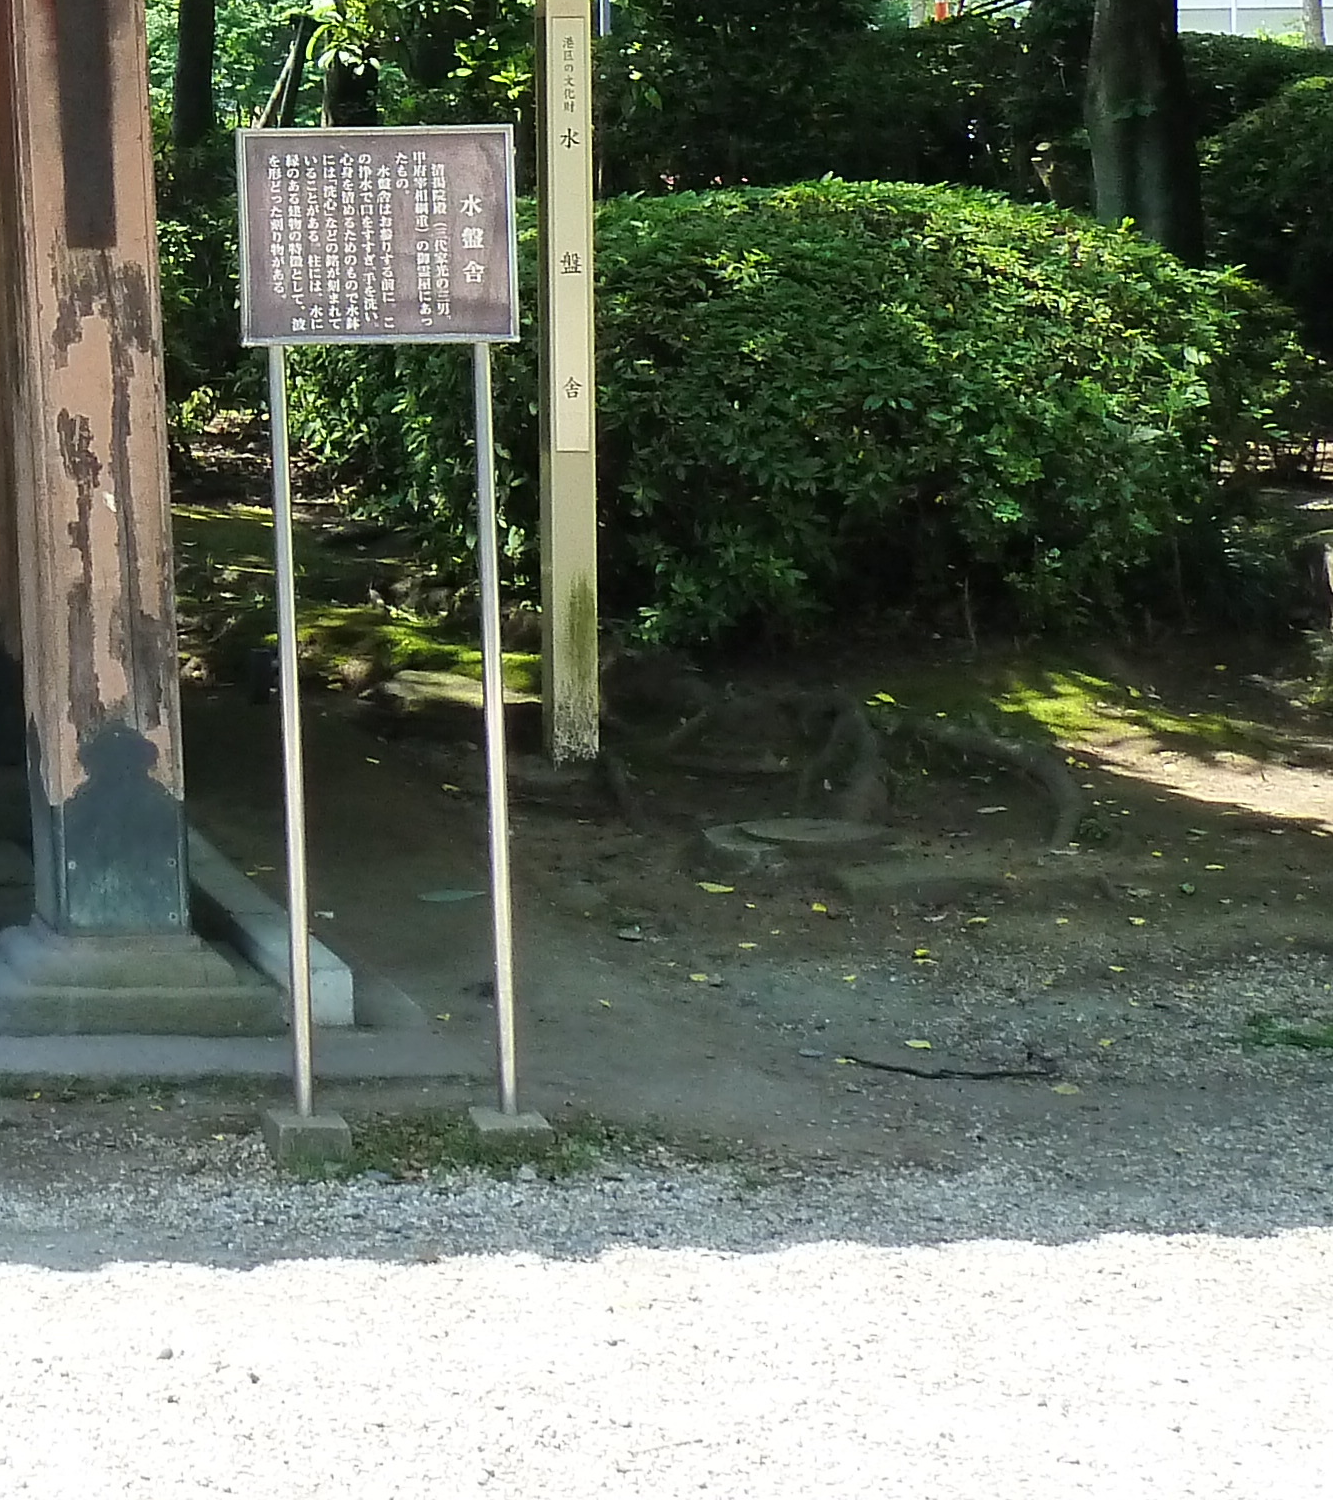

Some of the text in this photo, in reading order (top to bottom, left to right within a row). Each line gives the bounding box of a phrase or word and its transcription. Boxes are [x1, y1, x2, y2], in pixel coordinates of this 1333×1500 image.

[562, 36, 576, 113] 港区の文化財
[460, 194, 485, 284] 水盤舎
[560, 128, 582, 399] 水盤舎
